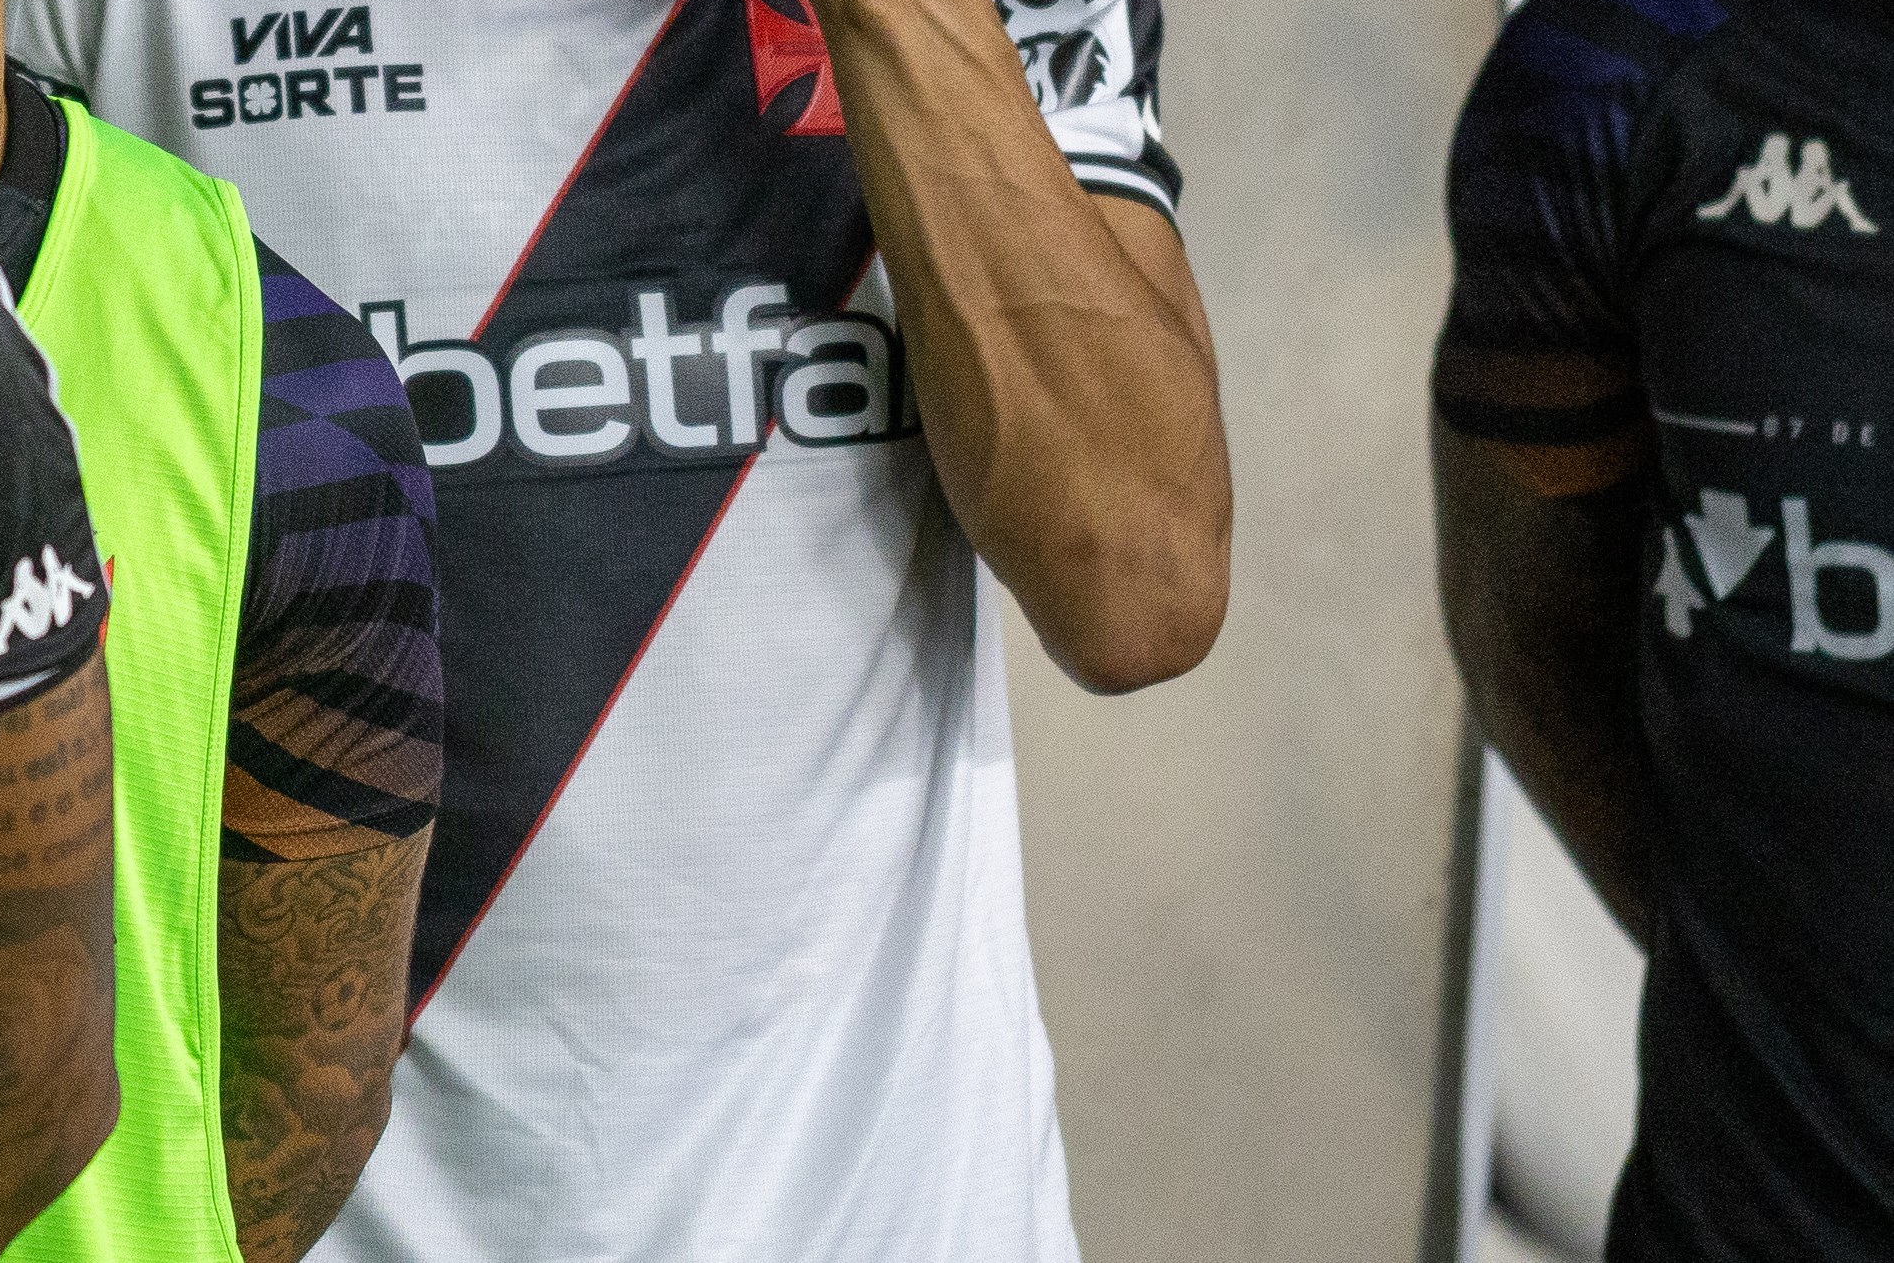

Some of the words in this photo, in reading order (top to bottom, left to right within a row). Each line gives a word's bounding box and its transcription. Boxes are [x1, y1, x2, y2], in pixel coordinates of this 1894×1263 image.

[230, 5, 374, 64] VIVA
[189, 63, 427, 130] SORTE
[1761, 414, 1805, 441] 07
[1830, 419, 1877, 448] DE
[1780, 495, 1894, 660] b
